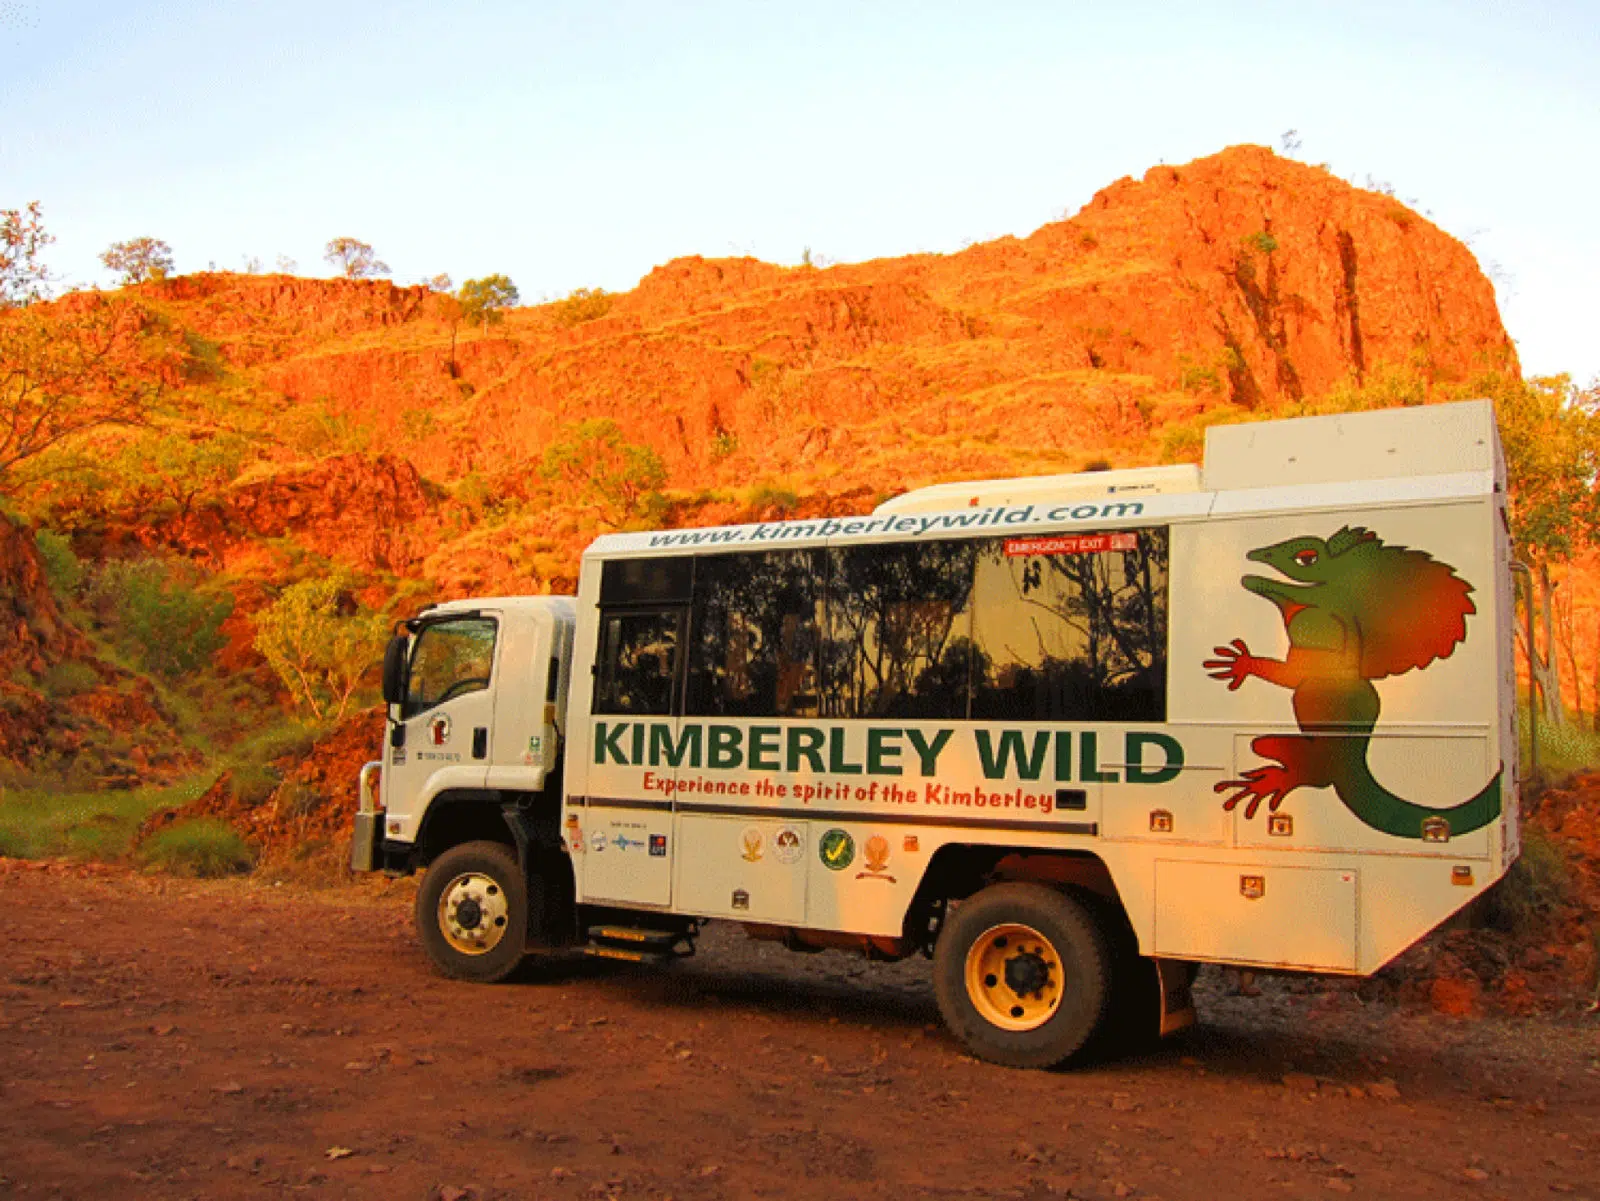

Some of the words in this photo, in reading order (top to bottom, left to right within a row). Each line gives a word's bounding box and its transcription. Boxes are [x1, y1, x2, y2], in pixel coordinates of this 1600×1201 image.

[649, 502, 1144, 547] www.kimberleywild.com
[1080, 536, 1105, 549] EXIT
[593, 723, 955, 777] KIMBERLEY
[974, 729, 1185, 784] WILD
[643, 772, 750, 796] Experience
[755, 778, 787, 798] the
[792, 782, 850, 803] spirit
[855, 782, 878, 801] of
[881, 783, 917, 804] the
[925, 783, 1053, 813] Kimberley
